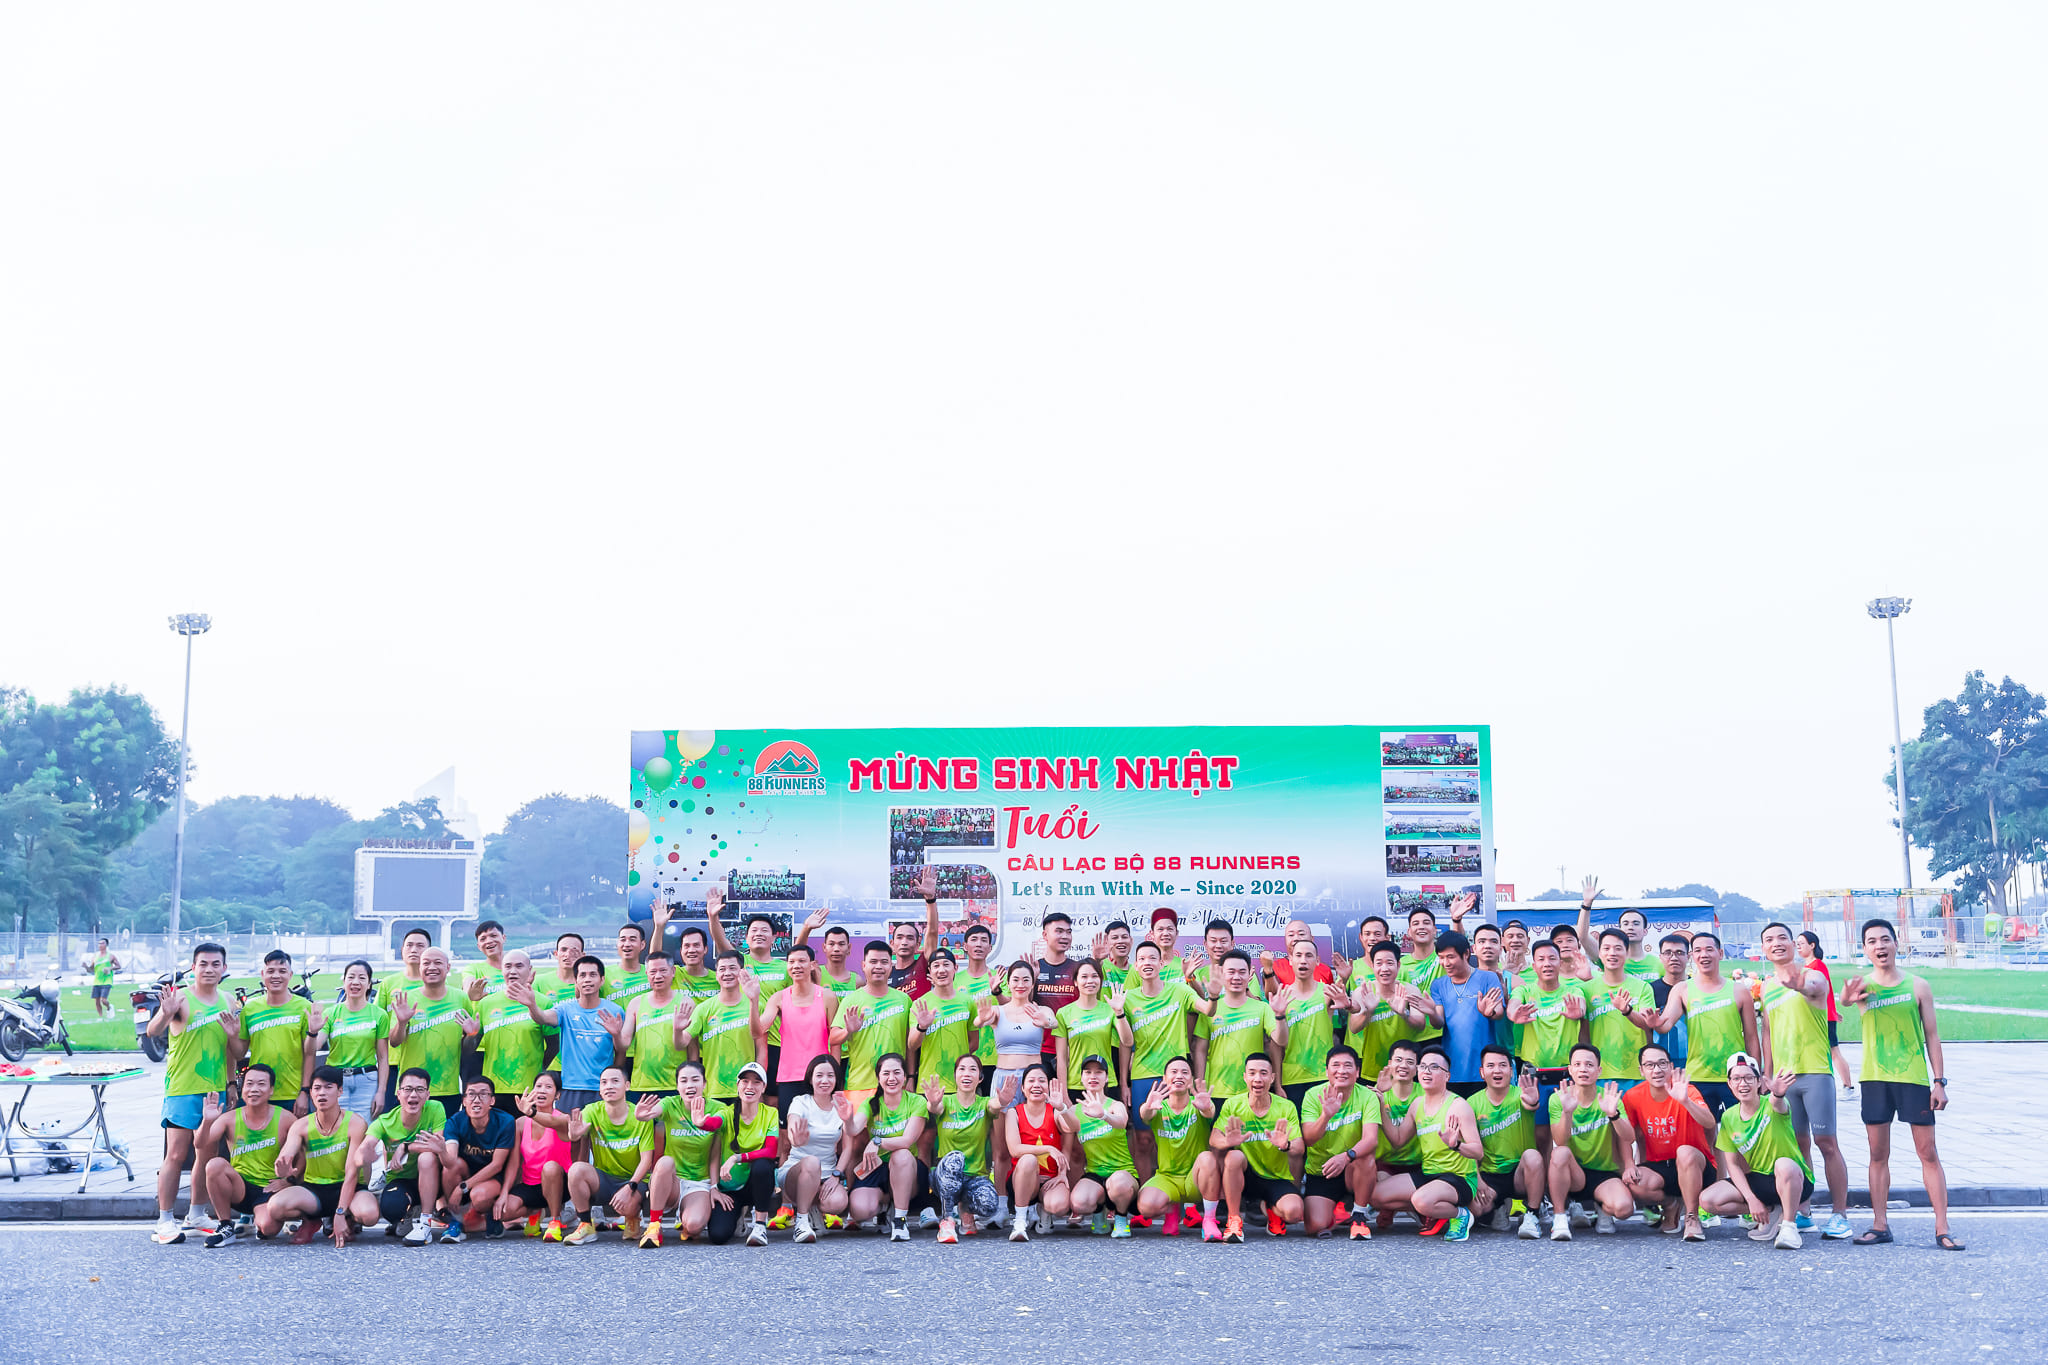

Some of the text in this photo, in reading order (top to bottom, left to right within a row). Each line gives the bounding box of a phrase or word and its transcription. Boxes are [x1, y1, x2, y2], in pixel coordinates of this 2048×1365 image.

[748, 775, 825, 790] 88 RUNNERS
[849, 750, 1238, 797] MỪNG SINH NHẬT
[1008, 853, 1301, 874] CÂU LẠC BỘ 88 RUNNERS
[888, 804, 1100, 966] 5 Tuổi
[1011, 880, 1053, 896] Let's
[1058, 880, 1096, 896] Run
[1101, 880, 1144, 896] With
[1149, 880, 1175, 896] Me
[1196, 879, 1245, 895] Since
[1250, 879, 1297, 895] 2020
[1037, 984, 1076, 994] FINISHER
